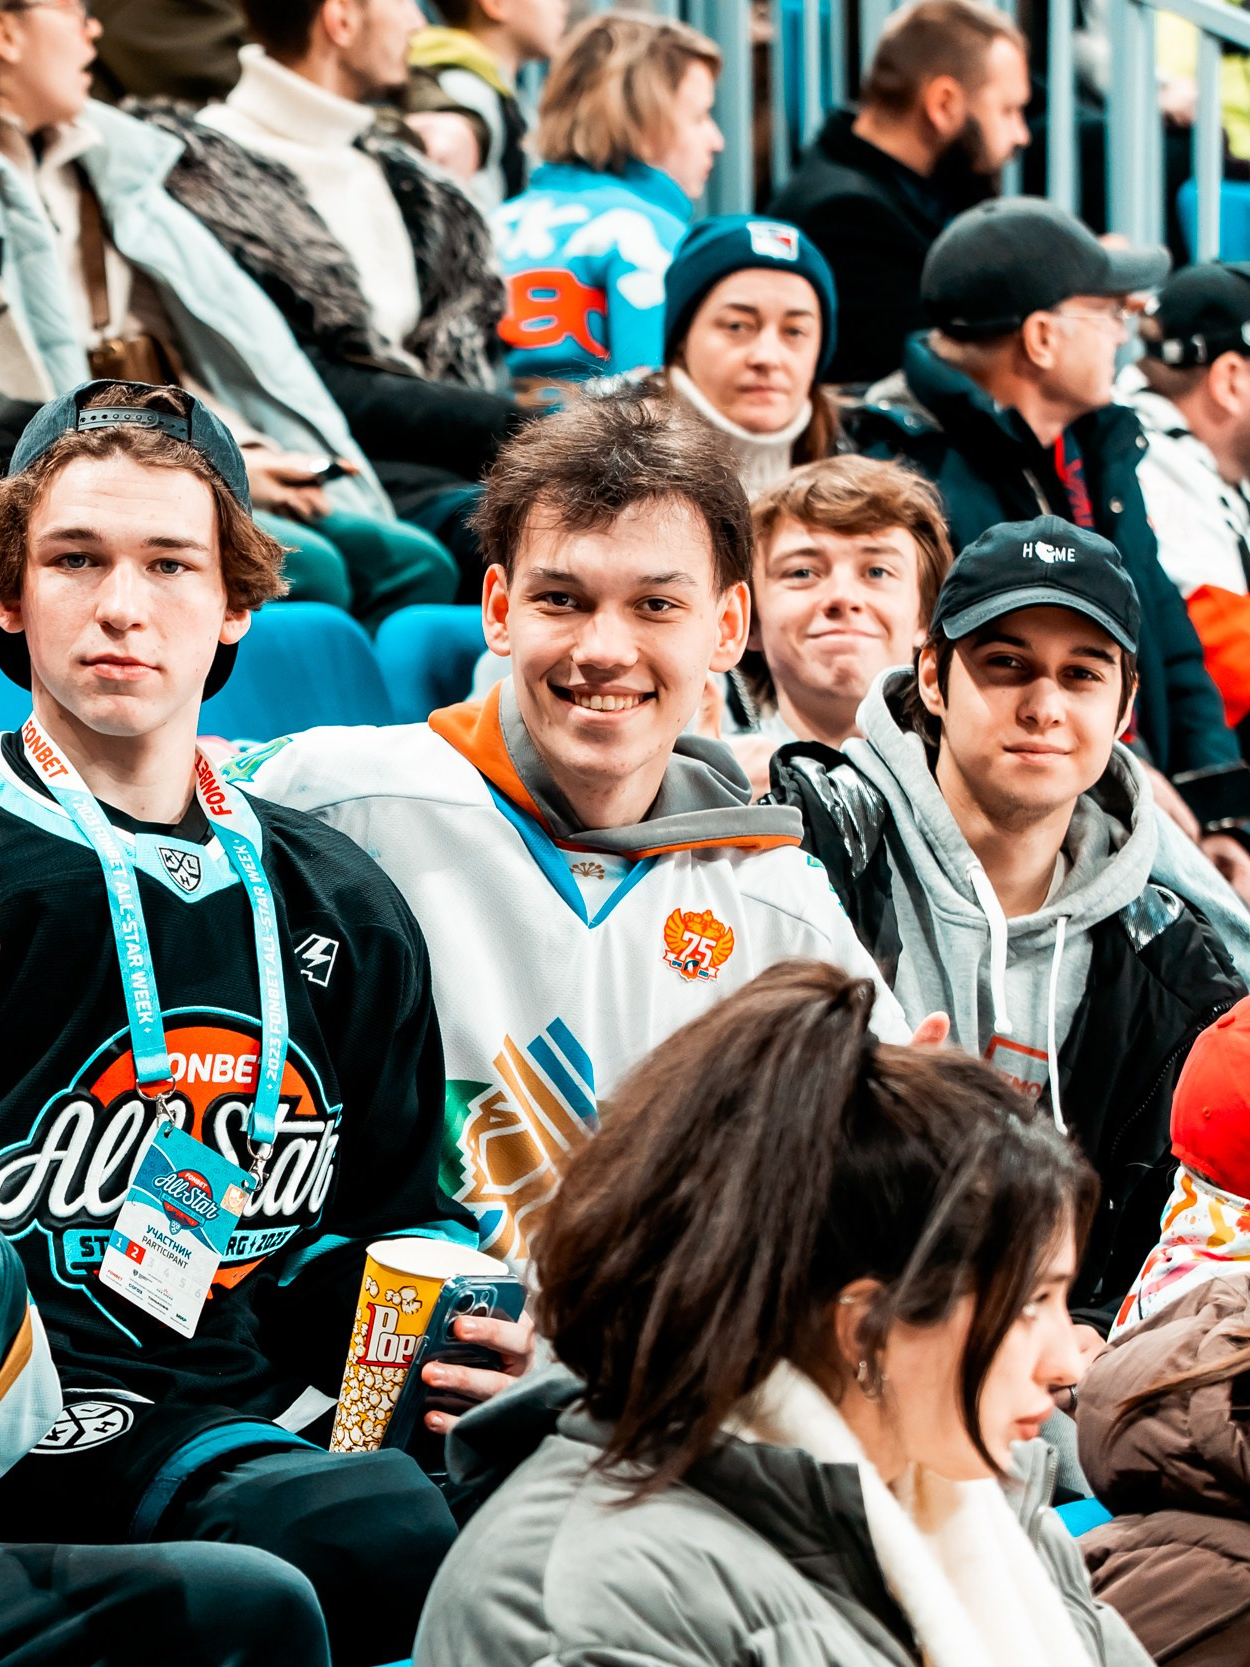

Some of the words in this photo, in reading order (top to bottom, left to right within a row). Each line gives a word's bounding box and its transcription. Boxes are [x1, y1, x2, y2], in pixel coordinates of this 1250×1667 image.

[22, 719, 69, 780] FONBET
[195, 754, 233, 816] FONBET
[234, 844, 263, 883] WEEK
[72, 797, 101, 828] 2023
[90, 826, 128, 877] FONBET
[115, 881, 145, 968] ALL-STAR
[130, 971, 154, 1023] WEEK
[252, 885, 279, 965] ALL-STAR
[678, 930, 718, 968] 75
[265, 966, 282, 1035] FONBET
[168, 1052, 261, 1084] ONBE
[266, 1036, 282, 1081] 2023
[184, 1172, 209, 1190] FONBET
[130, 1249, 139, 1259] 2
[141, 1234, 189, 1270] PARTICIPANT
[146, 1223, 193, 1261] УЧАСТНИК
